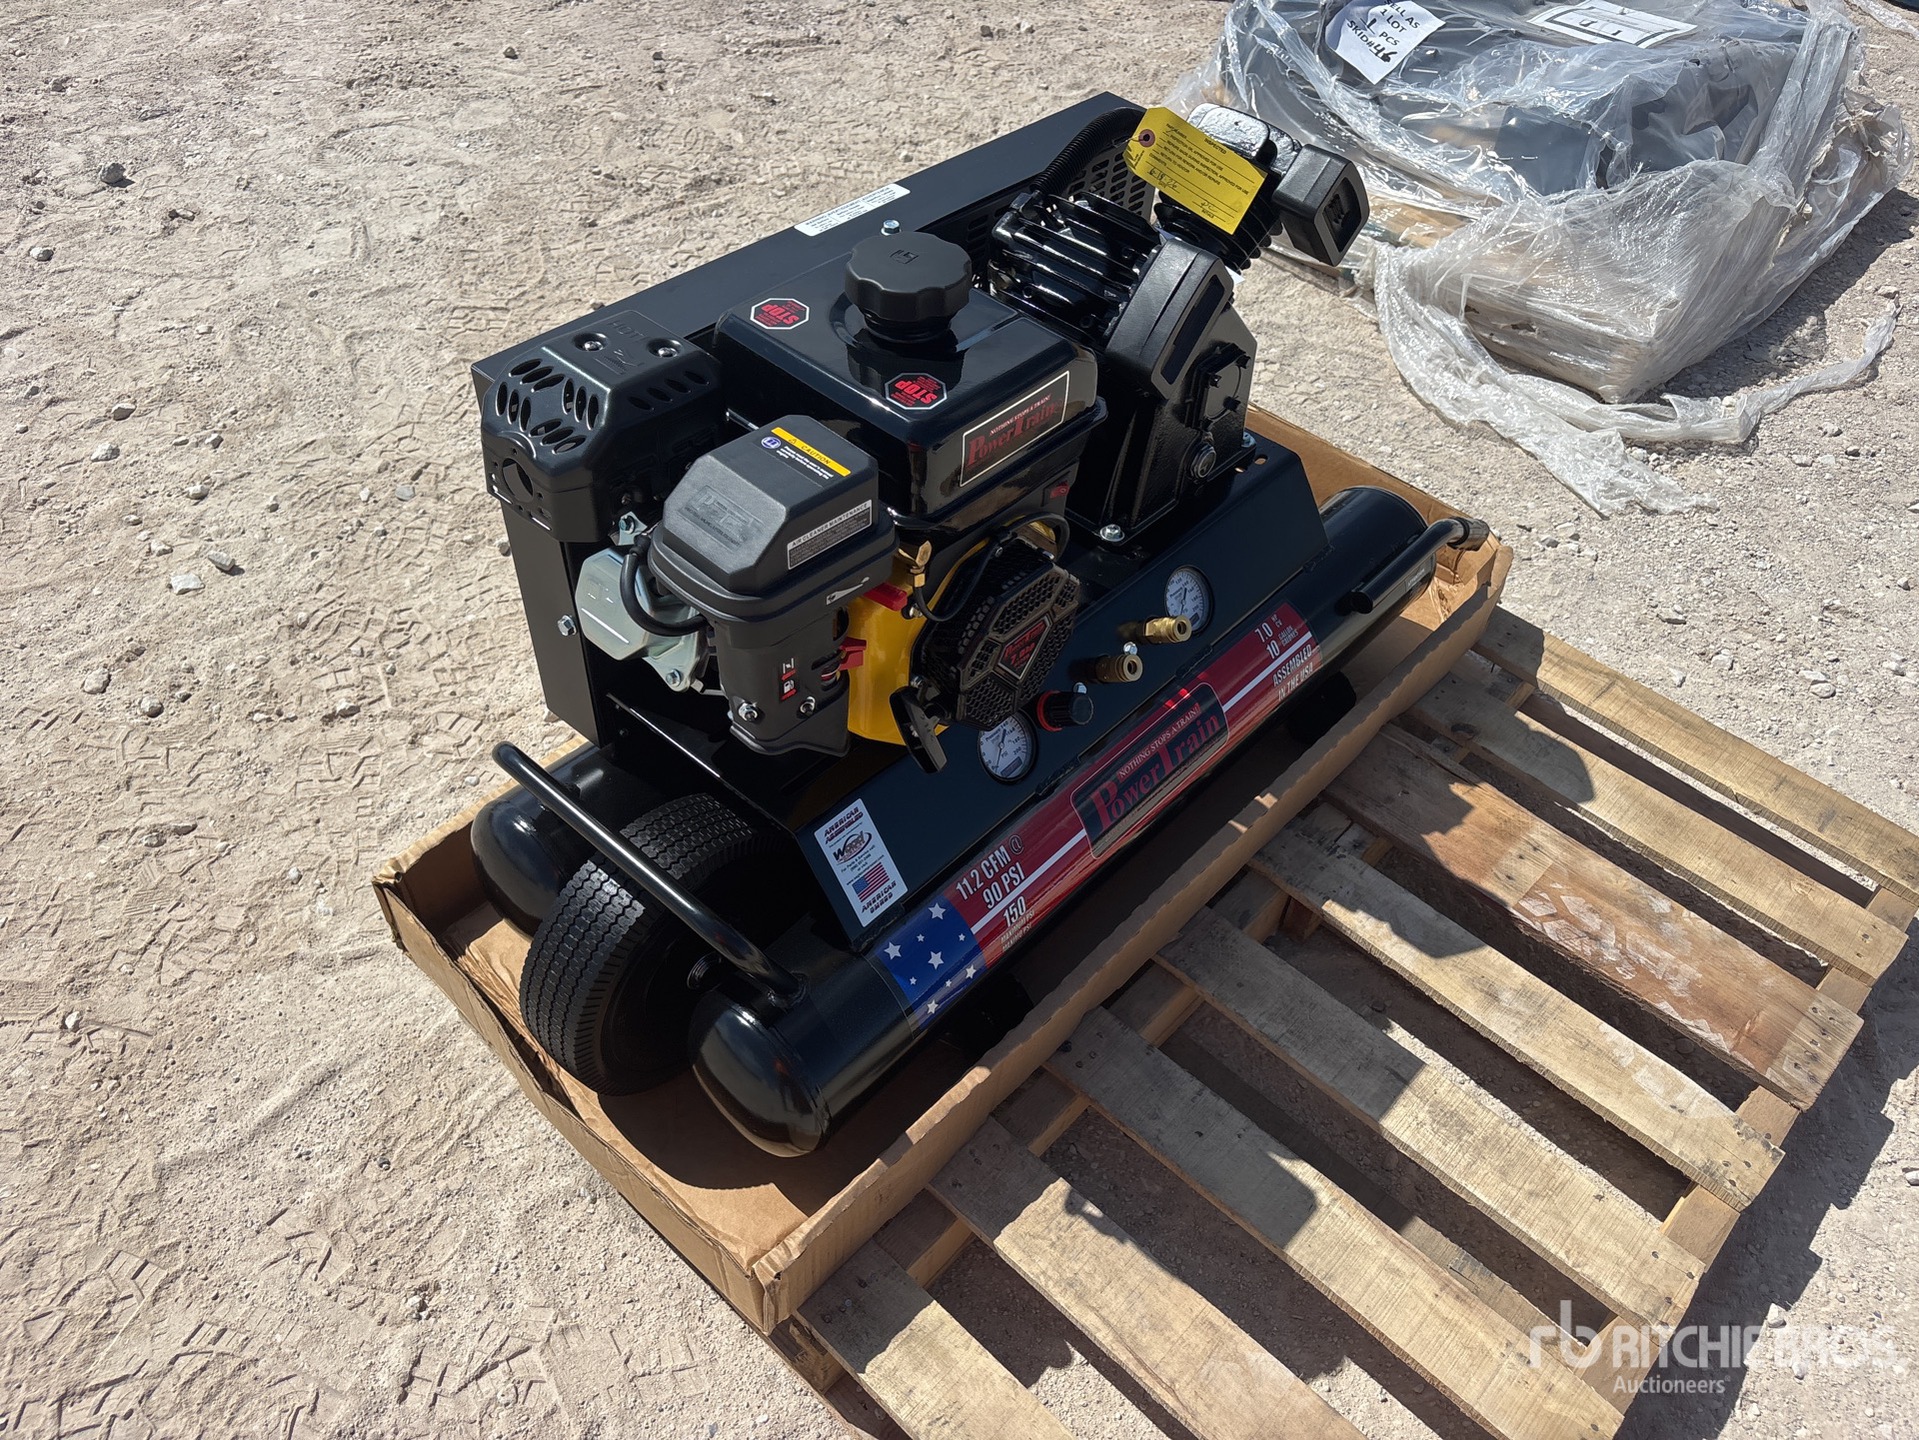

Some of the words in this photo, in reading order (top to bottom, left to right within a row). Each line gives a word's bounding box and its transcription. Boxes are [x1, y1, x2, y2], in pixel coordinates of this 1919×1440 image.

[1379, 8, 1387, 16] 1
[1386, 15, 1407, 32] LOT
[1384, 0, 1404, 16] SELL
[1405, 16, 1420, 28] AS
[1378, 31, 1399, 45] PCS
[1203, 137, 1227, 154] INSPECTED
[760, 302, 800, 326] STOP
[898, 379, 937, 405] STOP
[801, 445, 830, 464] CAUTION
[792, 538, 803, 547] AIR
[802, 524, 829, 543] CLEANER
[828, 503, 868, 530] MAINTENANCE
[1254, 622, 1273, 643] 7.0
[1266, 639, 1280, 659] 10
[1272, 644, 1313, 687] ASSEMBLED
[1277, 683, 1287, 702] IN
[1286, 674, 1299, 696] THE
[1299, 662, 1313, 686] USA
[1118, 746, 1150, 779] NOTHING
[1149, 728, 1171, 752] STOPS
[1170, 723, 1177, 734] A
[1175, 706, 1201, 729] TRAIN!
[1090, 714, 1220, 833] PowerTrain
[824, 806, 859, 836] AMERICAN
[955, 868, 984, 901] 11.2
[980, 845, 1011, 879] CFM
[1008, 834, 1025, 855] @
[862, 881, 896, 913] AMERICAN
[983, 880, 1004, 909] 90
[1000, 861, 1026, 893] PSI
[1003, 896, 1026, 927] 150
